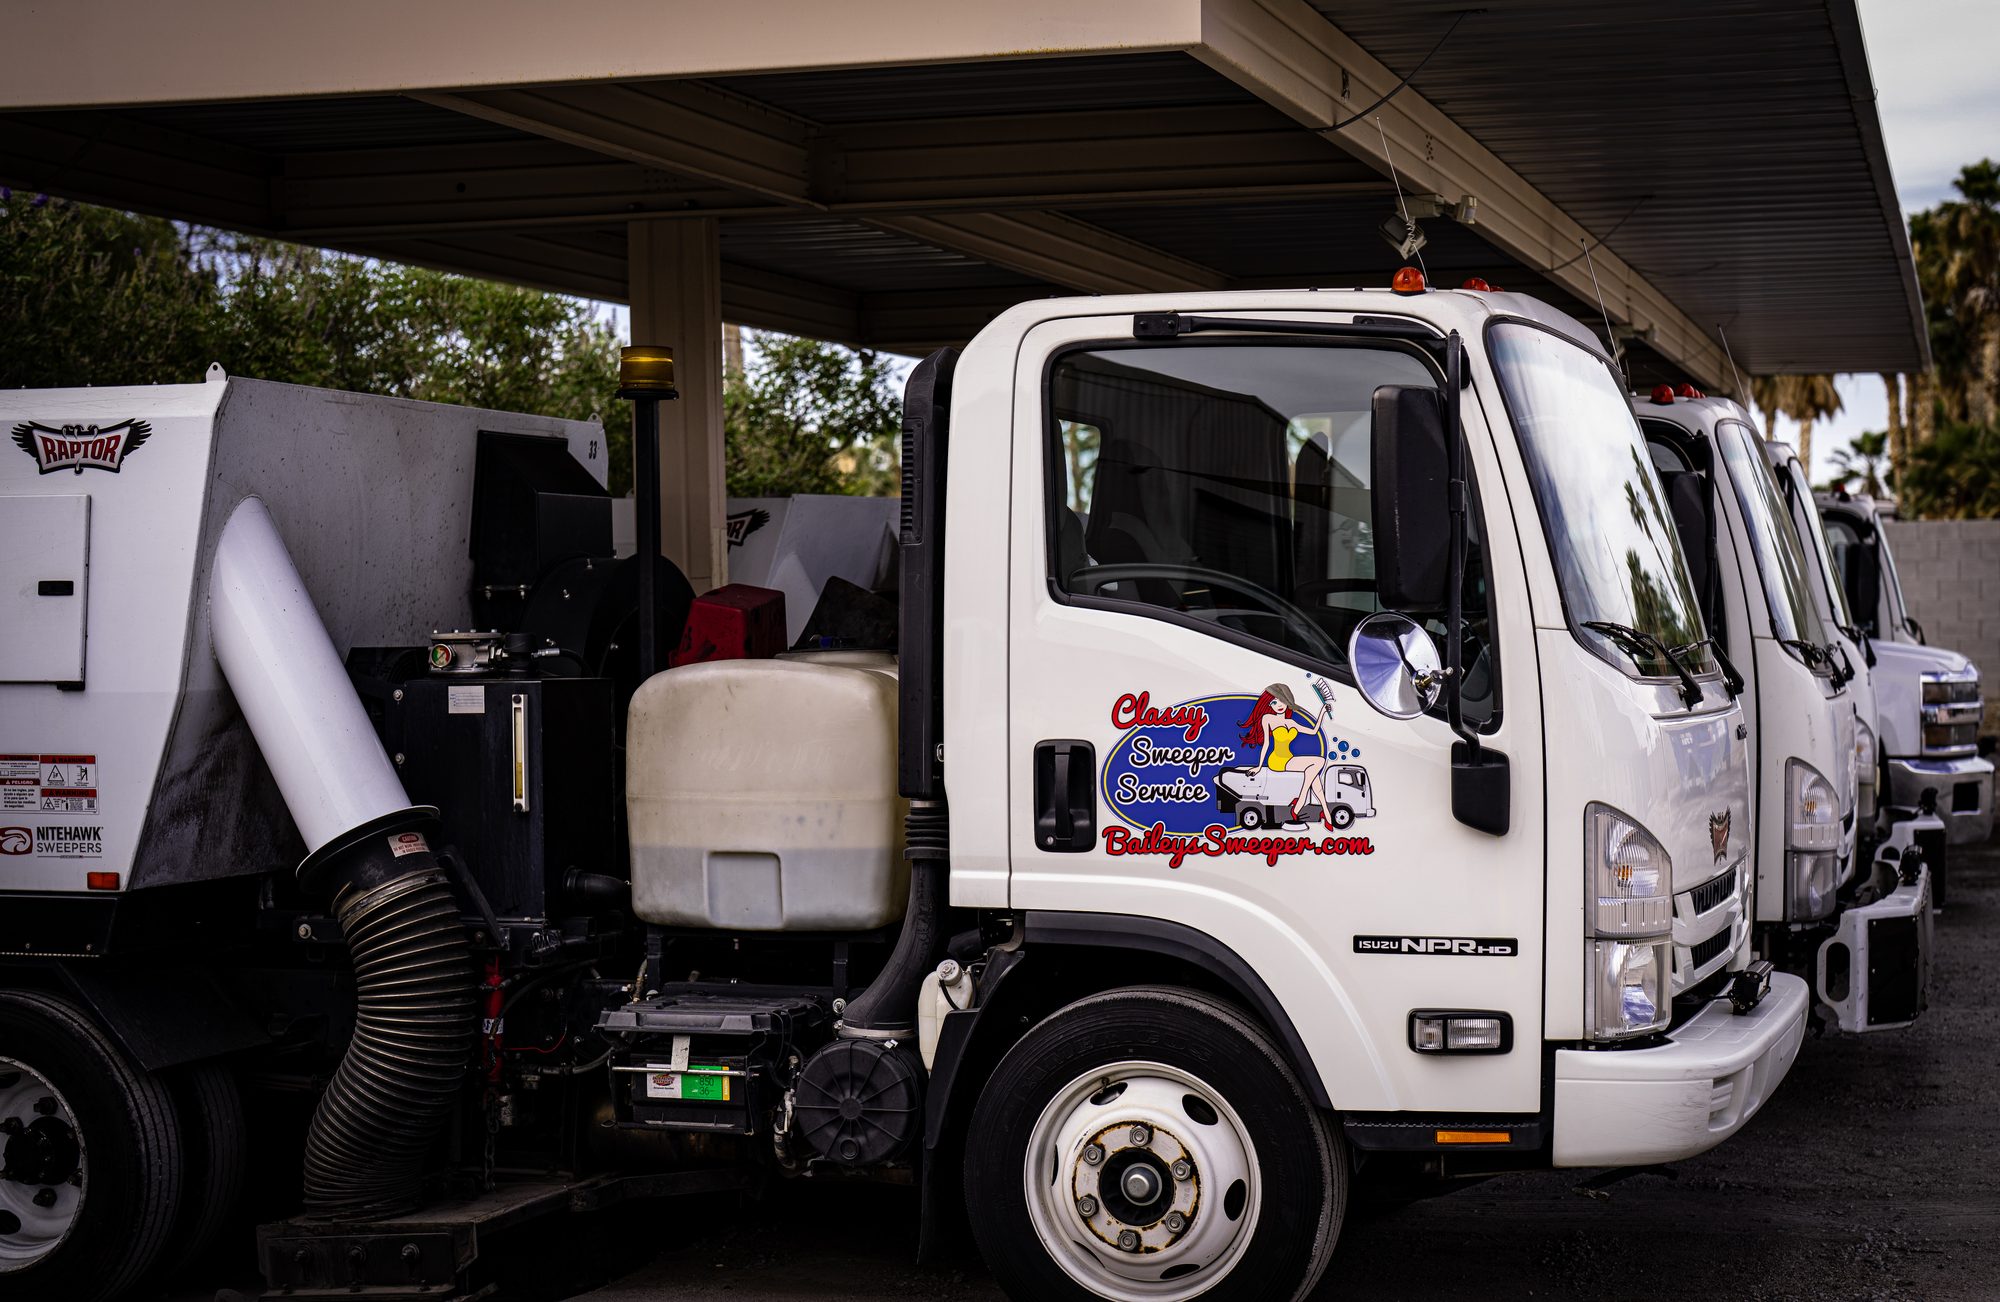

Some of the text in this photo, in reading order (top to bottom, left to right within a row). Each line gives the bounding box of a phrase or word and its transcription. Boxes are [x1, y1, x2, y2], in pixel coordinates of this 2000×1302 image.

[38, 434, 122, 465] RAPTOR
[1111, 690, 1208, 742] Classy
[1129, 737, 1234, 776] Sweeper
[1115, 773, 1209, 803] Service
[36, 826, 102, 841] NITEHAWK
[36, 842, 102, 853] SWEEPERS
[1102, 821, 1375, 869] BaileysSweeper.com
[1358, 940, 1399, 949] ISUZU
[699, 1077, 714, 1086] 850
[699, 1086, 710, 1096] 36
